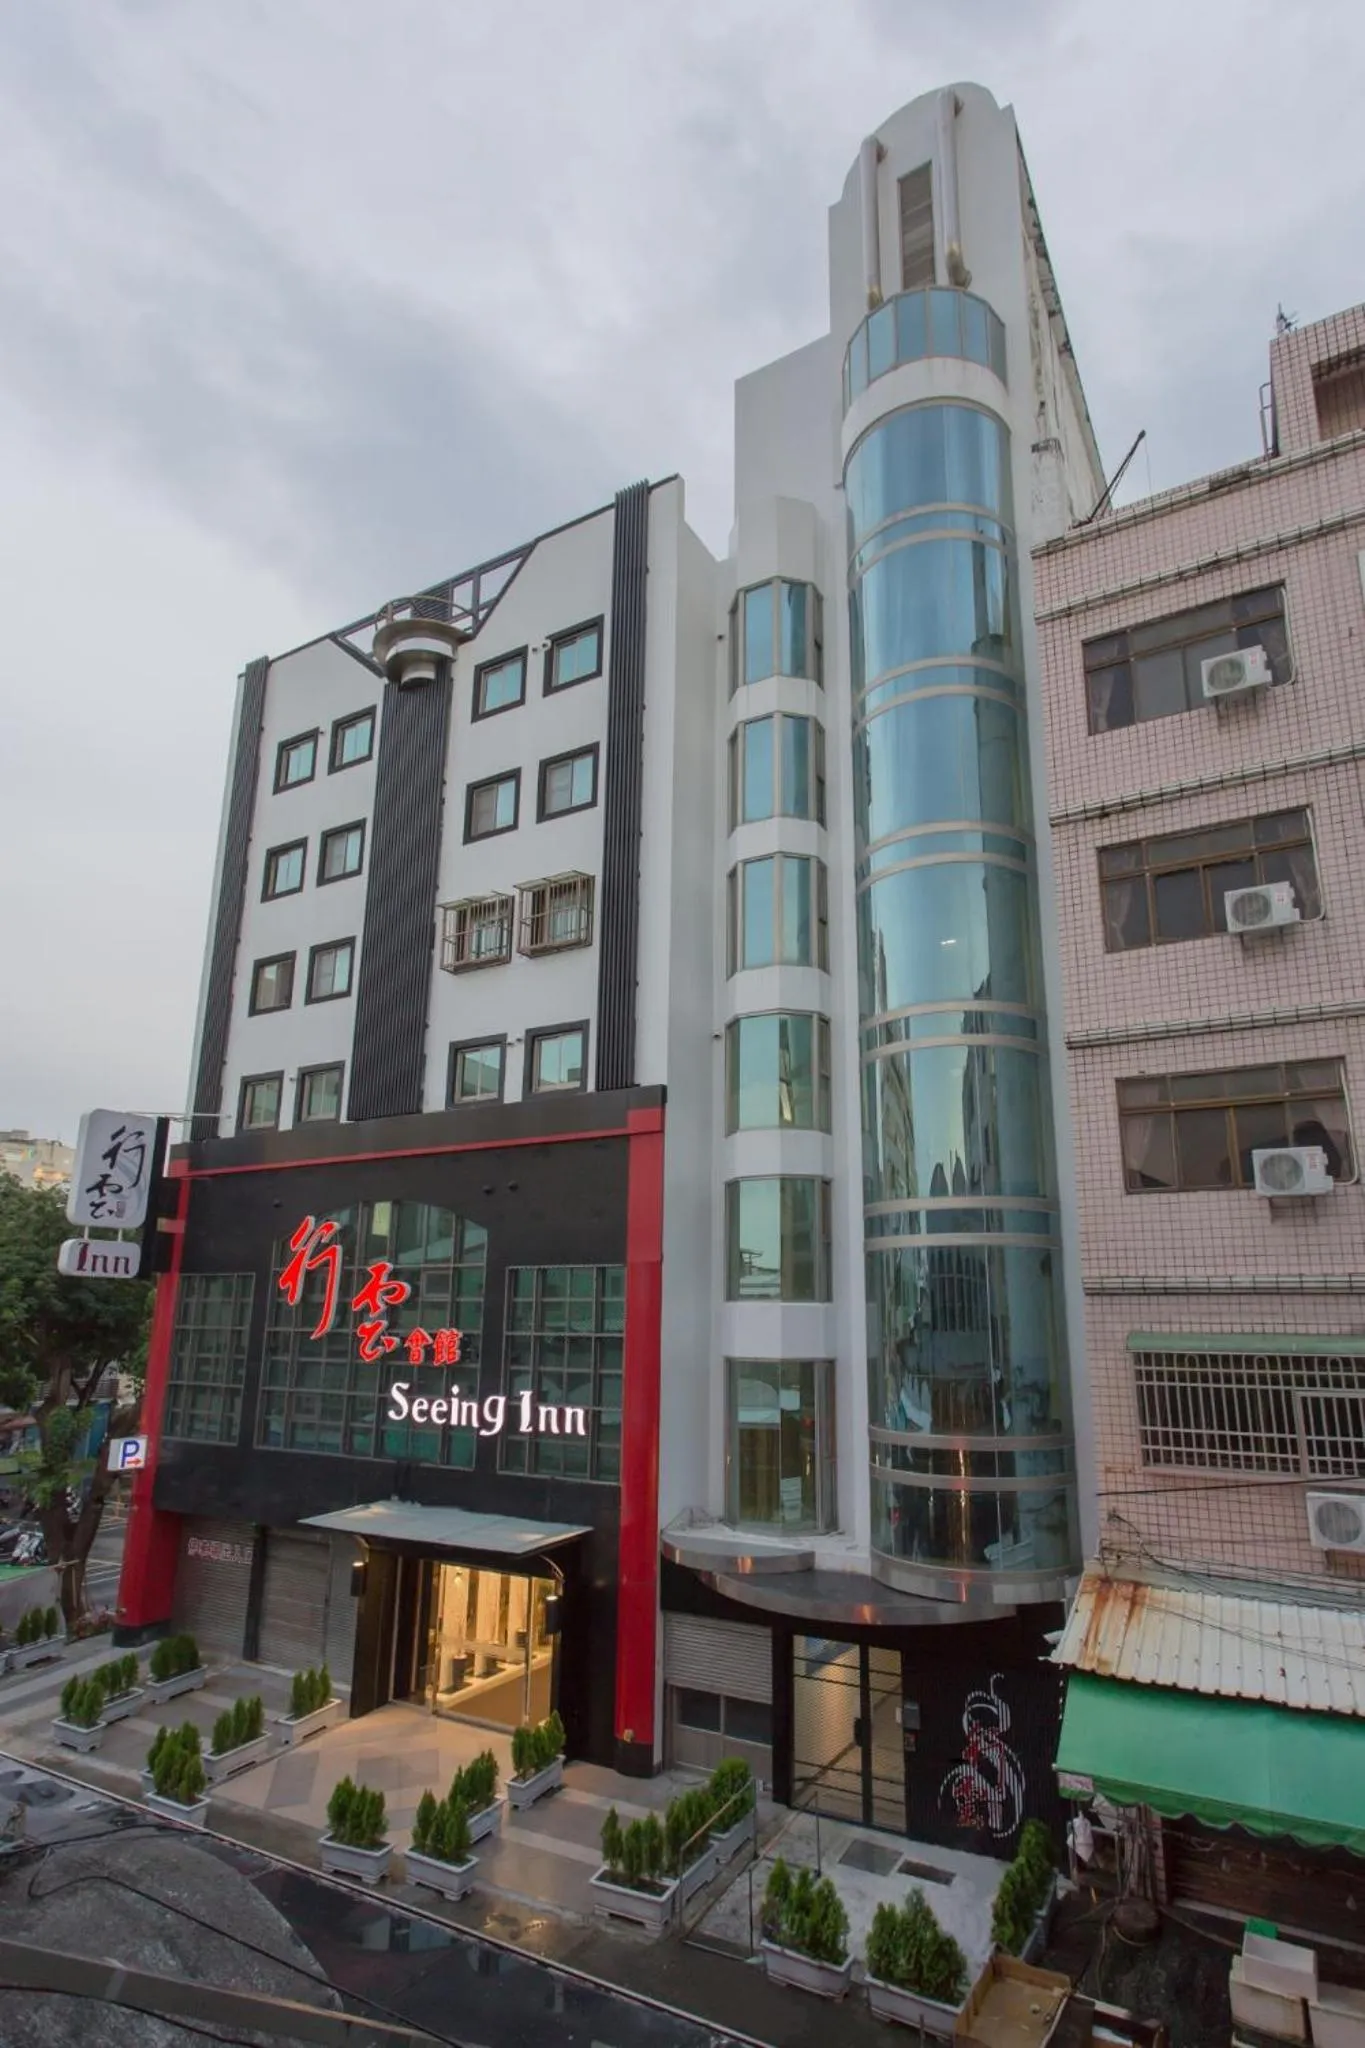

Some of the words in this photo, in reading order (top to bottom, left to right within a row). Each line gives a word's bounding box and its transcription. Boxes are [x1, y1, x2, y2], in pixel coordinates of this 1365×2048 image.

[75, 1242, 131, 1275] Inn
[387, 1381, 507, 1437] Seeing
[519, 1390, 588, 1437] Inn
[120, 1439, 140, 1469] P
